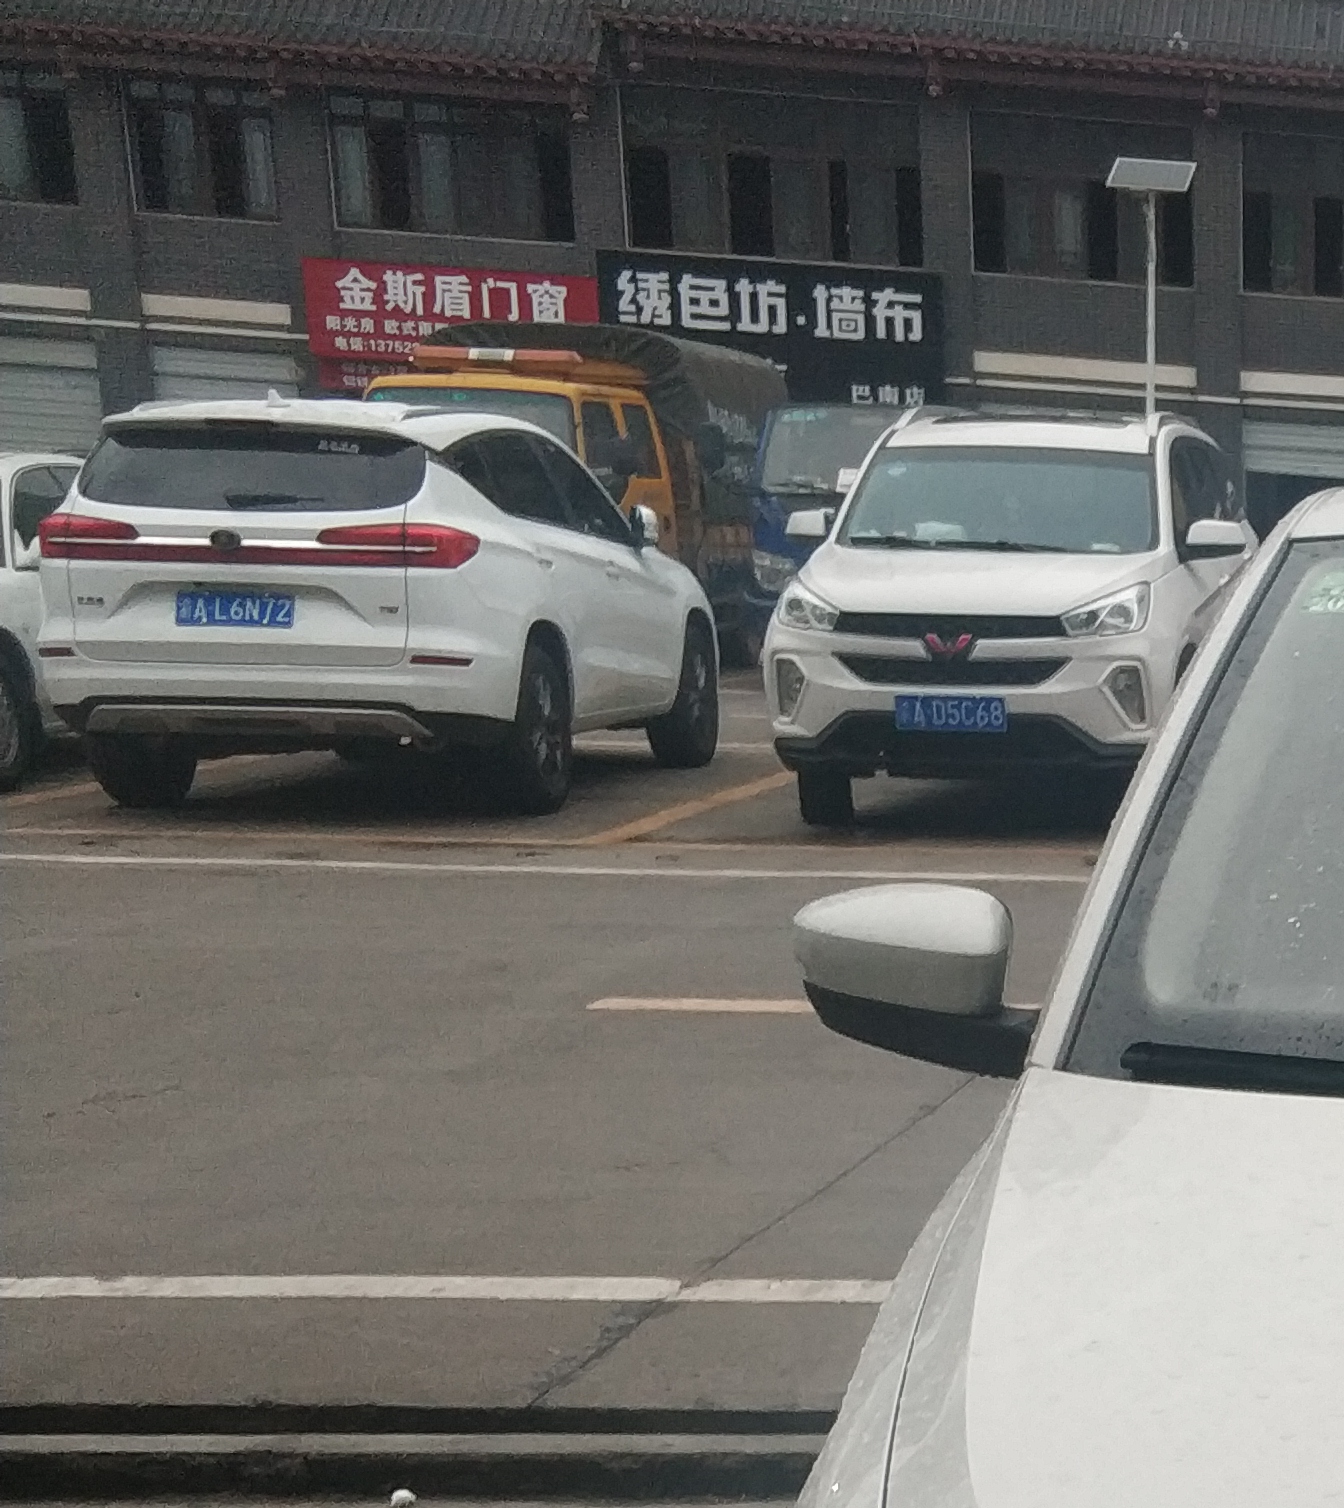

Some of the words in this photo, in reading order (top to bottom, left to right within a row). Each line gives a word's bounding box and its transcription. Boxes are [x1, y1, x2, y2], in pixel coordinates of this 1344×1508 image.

[335, 267, 567, 323] 金斯盾门窗
[325, 315, 375, 334] 阳光房
[851, 384, 925, 407] 巴南店
